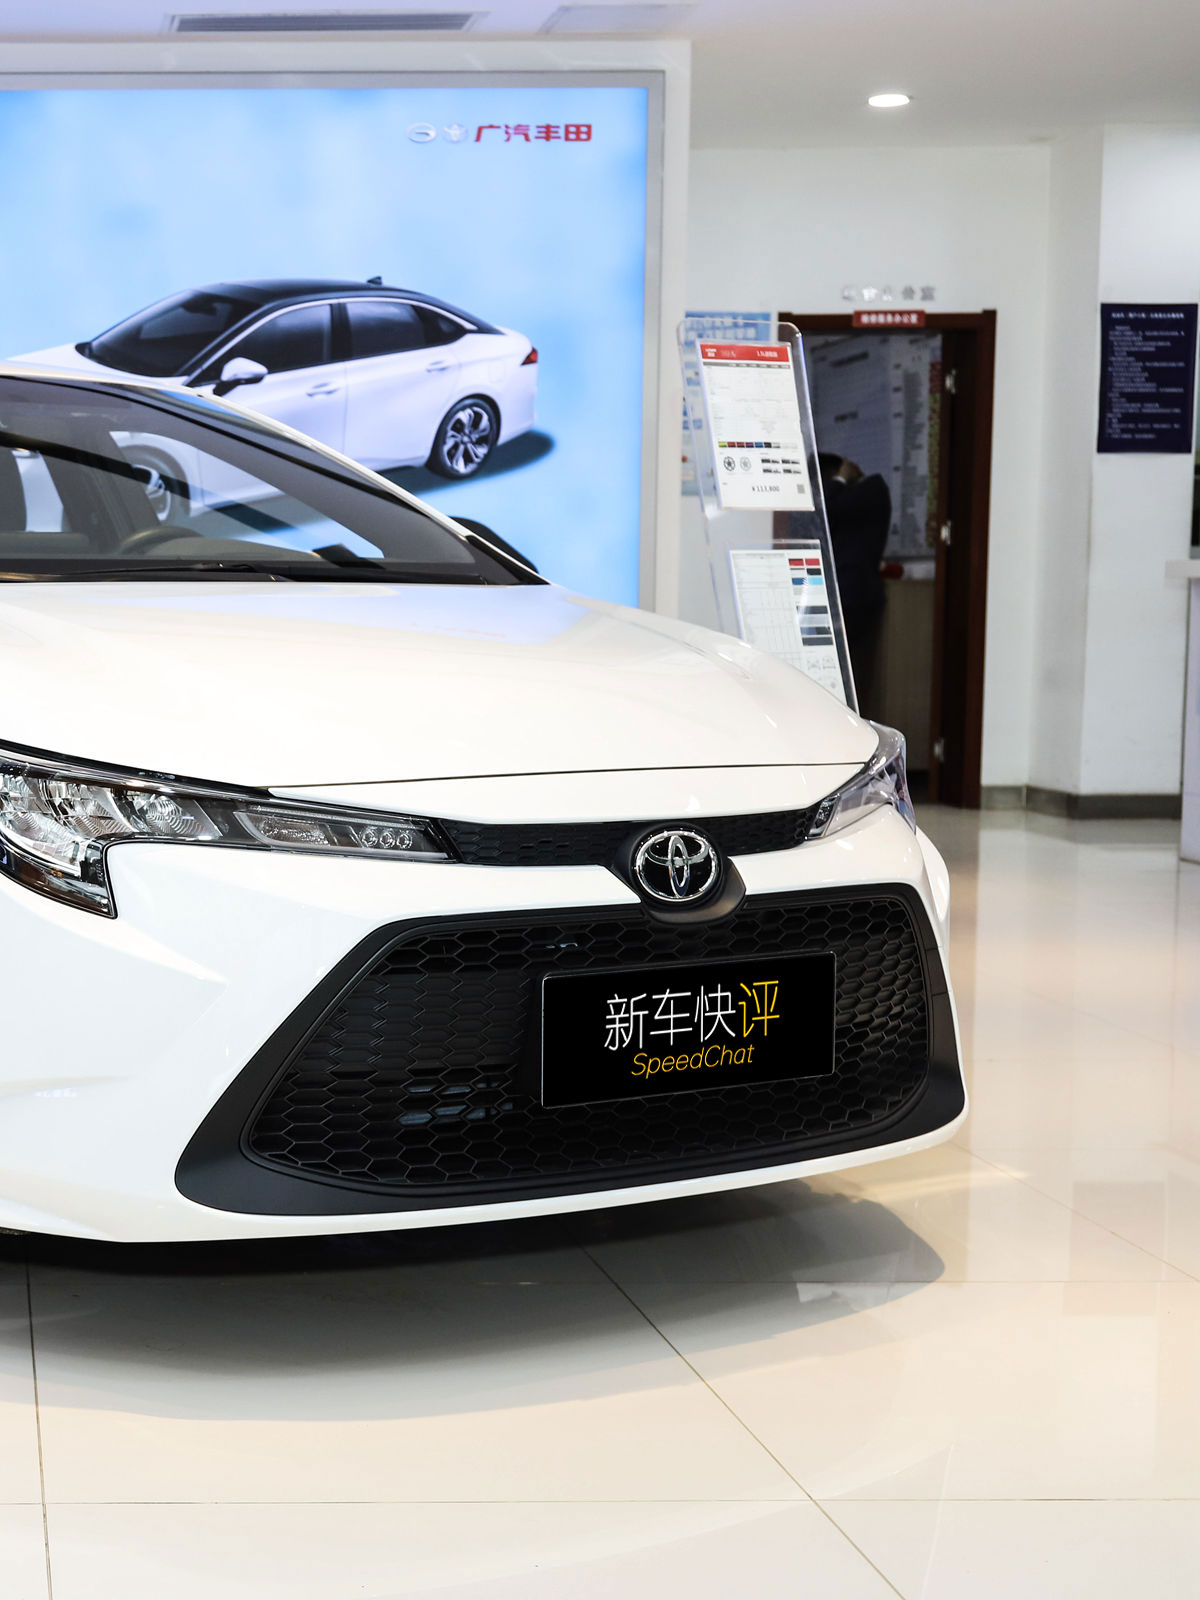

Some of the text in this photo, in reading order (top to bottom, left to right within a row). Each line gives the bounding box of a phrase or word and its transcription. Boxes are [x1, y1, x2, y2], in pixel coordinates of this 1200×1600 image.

[474, 123, 592, 142] 广汽丰田
[604, 980, 780, 1051] 新车快评
[631, 1043, 756, 1080] SpeedChat
